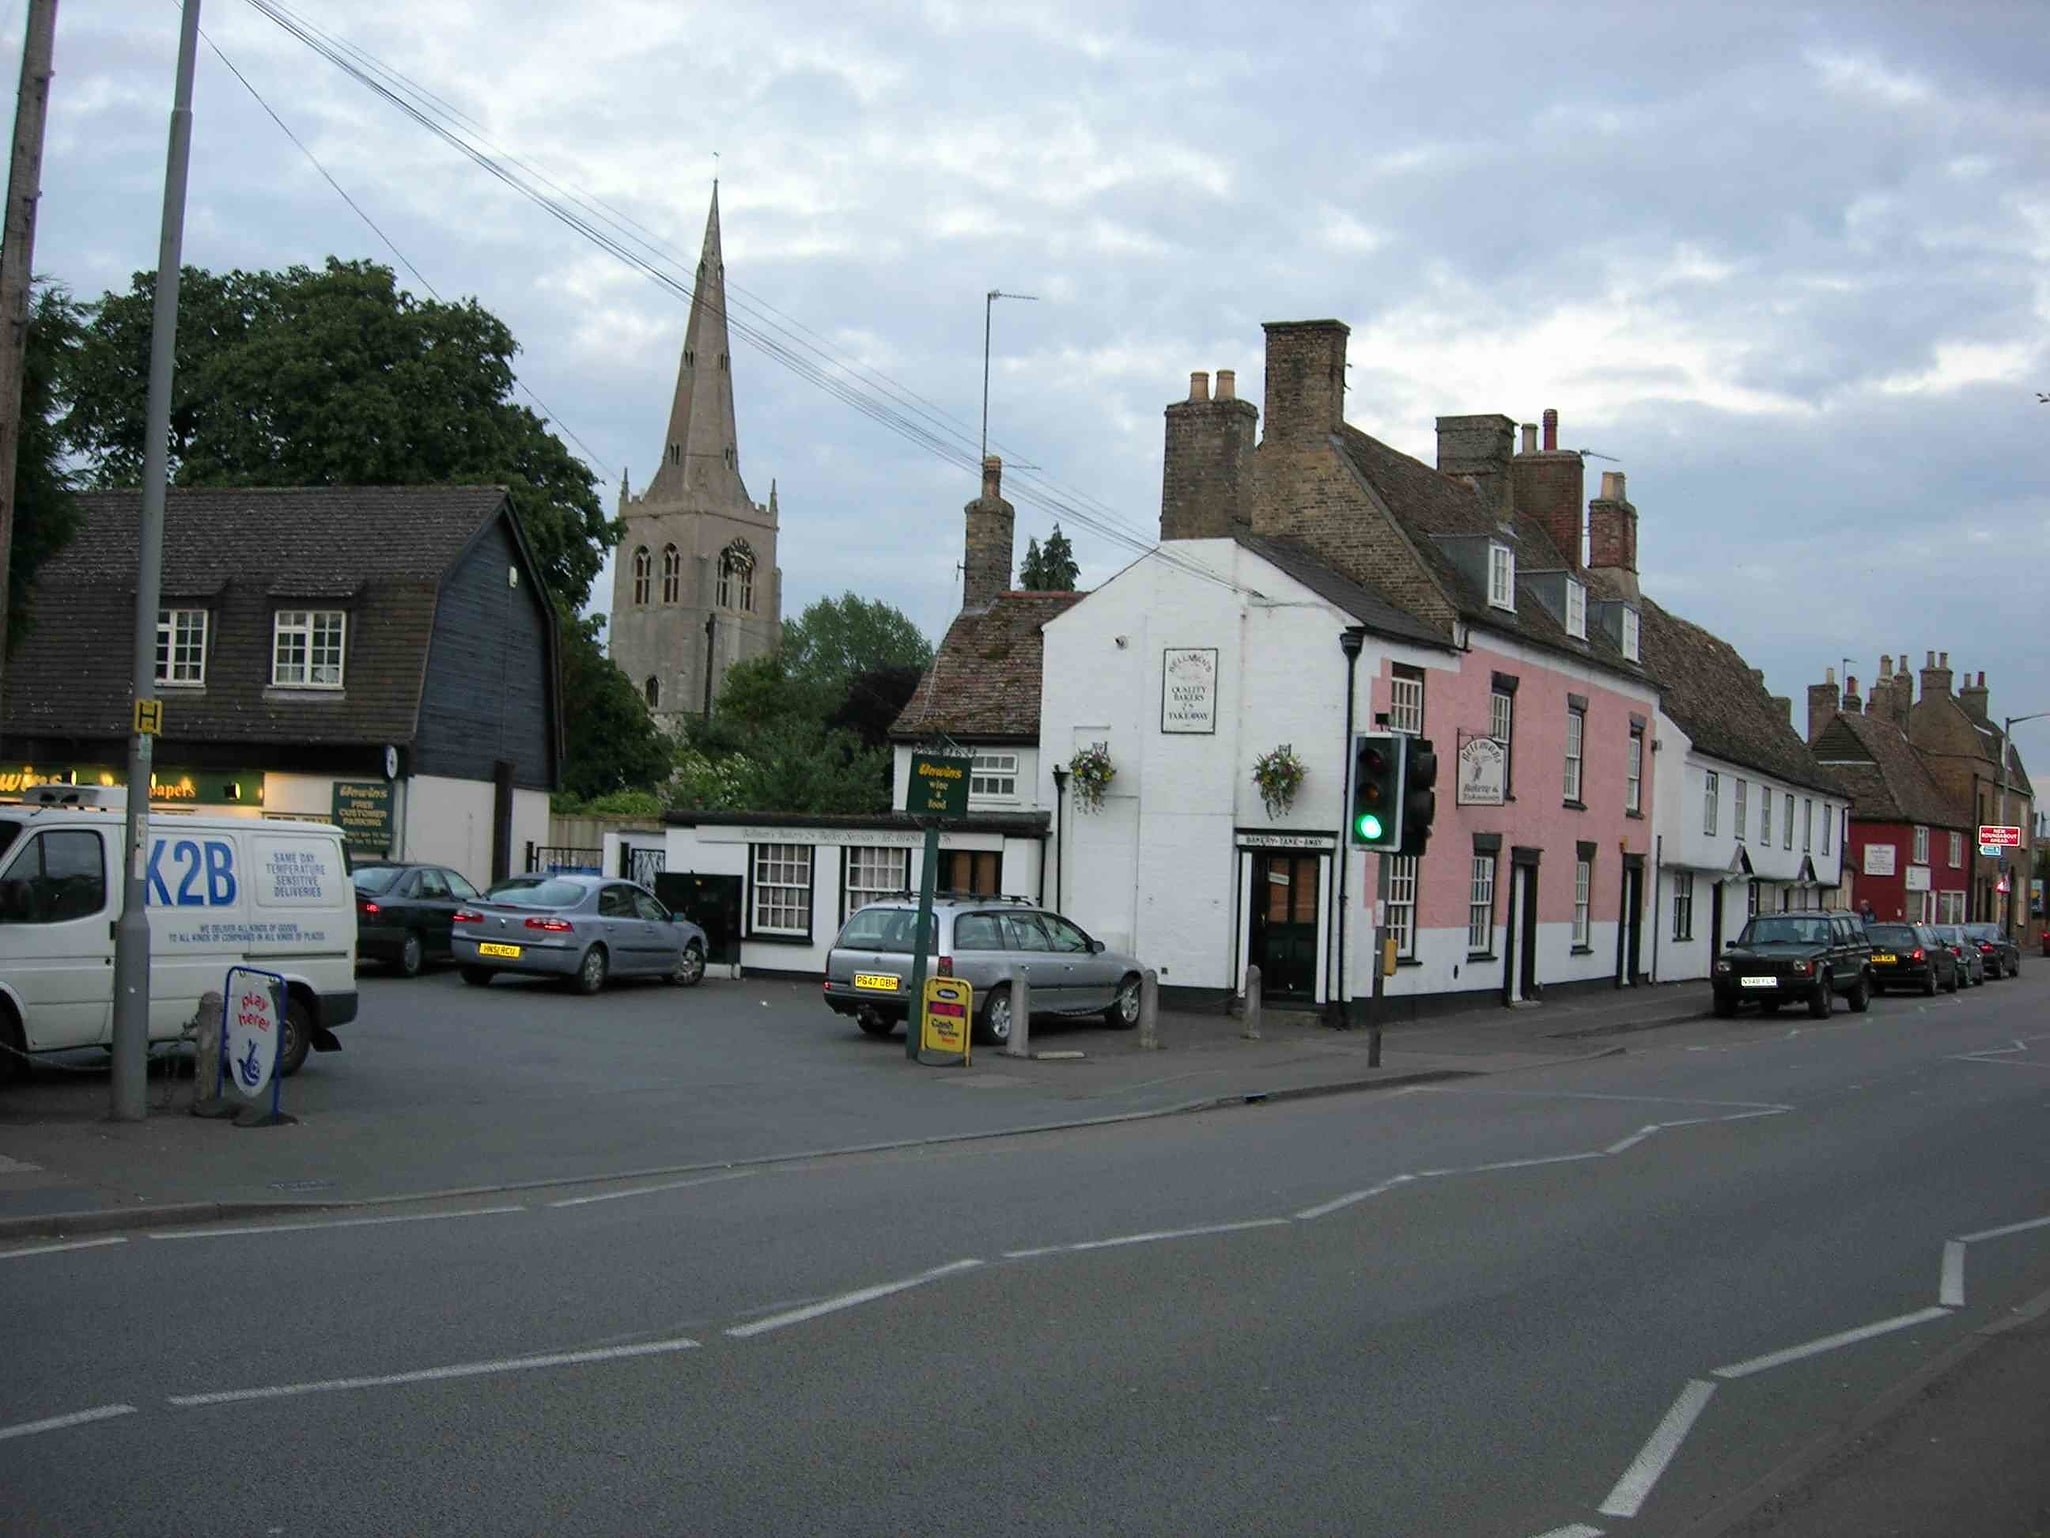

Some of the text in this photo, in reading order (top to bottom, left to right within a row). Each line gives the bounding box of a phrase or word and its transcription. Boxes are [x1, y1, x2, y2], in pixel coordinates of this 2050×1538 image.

[139, 702, 158, 729] H
[274, 853, 316, 864] SAME DAY
[146, 840, 237, 905] K2B
[266, 863, 326, 875] TEMPERATURE
[276, 876, 319, 887] SENSITIVE
[274, 886, 322, 898] DELIVERIES
[241, 990, 269, 1012] play
